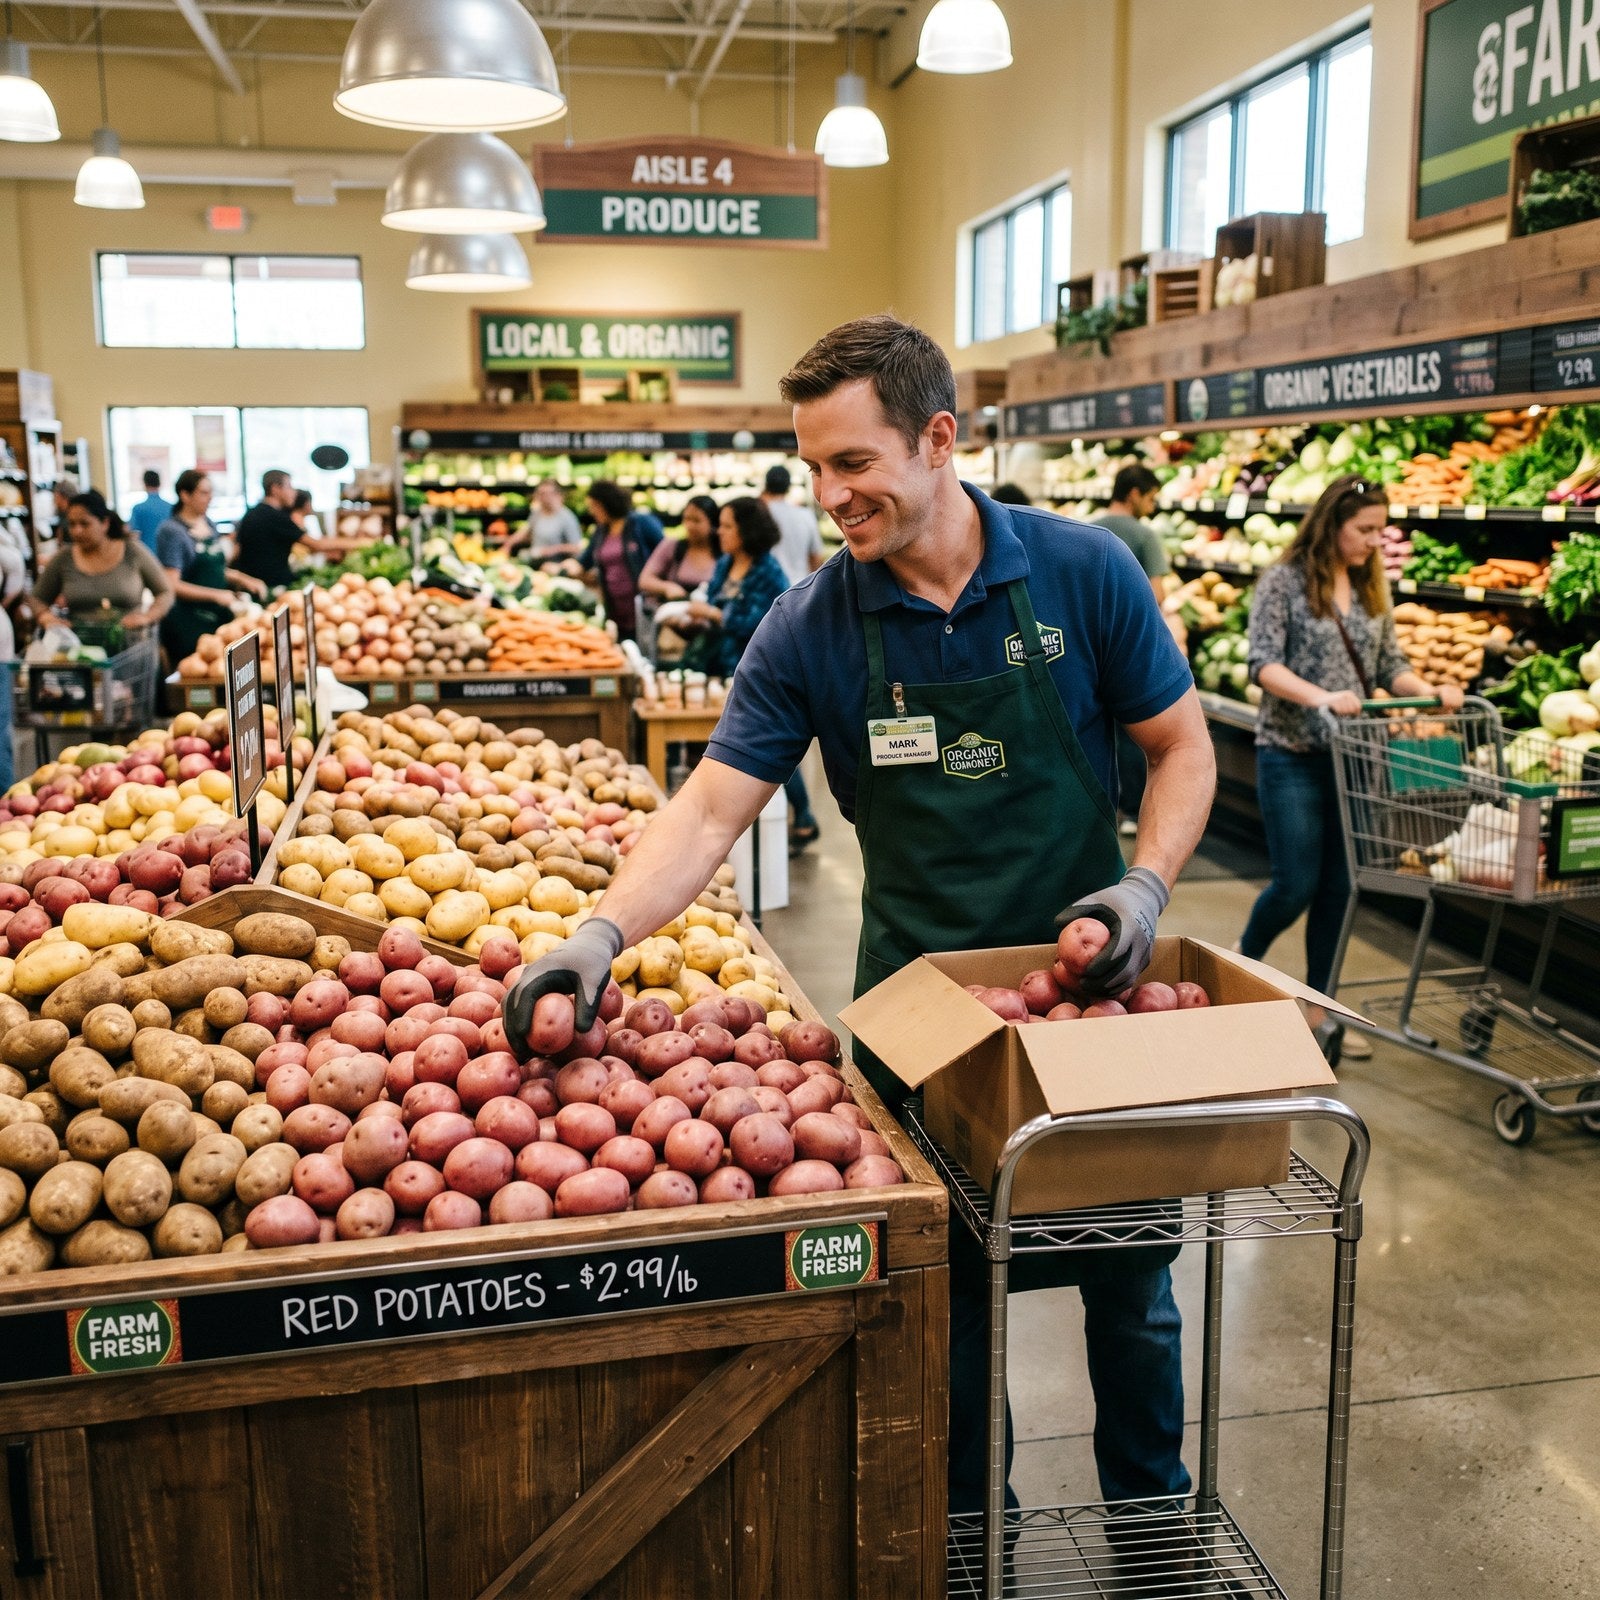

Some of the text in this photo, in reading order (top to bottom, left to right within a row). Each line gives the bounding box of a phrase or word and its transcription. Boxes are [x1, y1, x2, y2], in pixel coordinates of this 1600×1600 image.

[631, 155, 734, 185] AISLE 4
[602, 196, 761, 234] PRODUCE
[486, 322, 729, 358] LOCAL & ORGANIC
[1263, 365, 1330, 409] ORGANIC
[1331, 350, 1441, 402] VEGETABLES
[888, 739, 918, 749] MARK
[903, 750, 932, 758] MANAGER
[947, 745, 1000, 762] ORGANIC
[802, 1234, 861, 1259] FARM
[802, 1254, 862, 1278] FRESH
[282, 1294, 358, 1339] RED
[374, 1272, 547, 1327] POTATOES
[579, 1254, 699, 1303] $2.99/lb
[87, 1312, 160, 1340] FARM
[89, 1334, 161, 1360] FRESH
